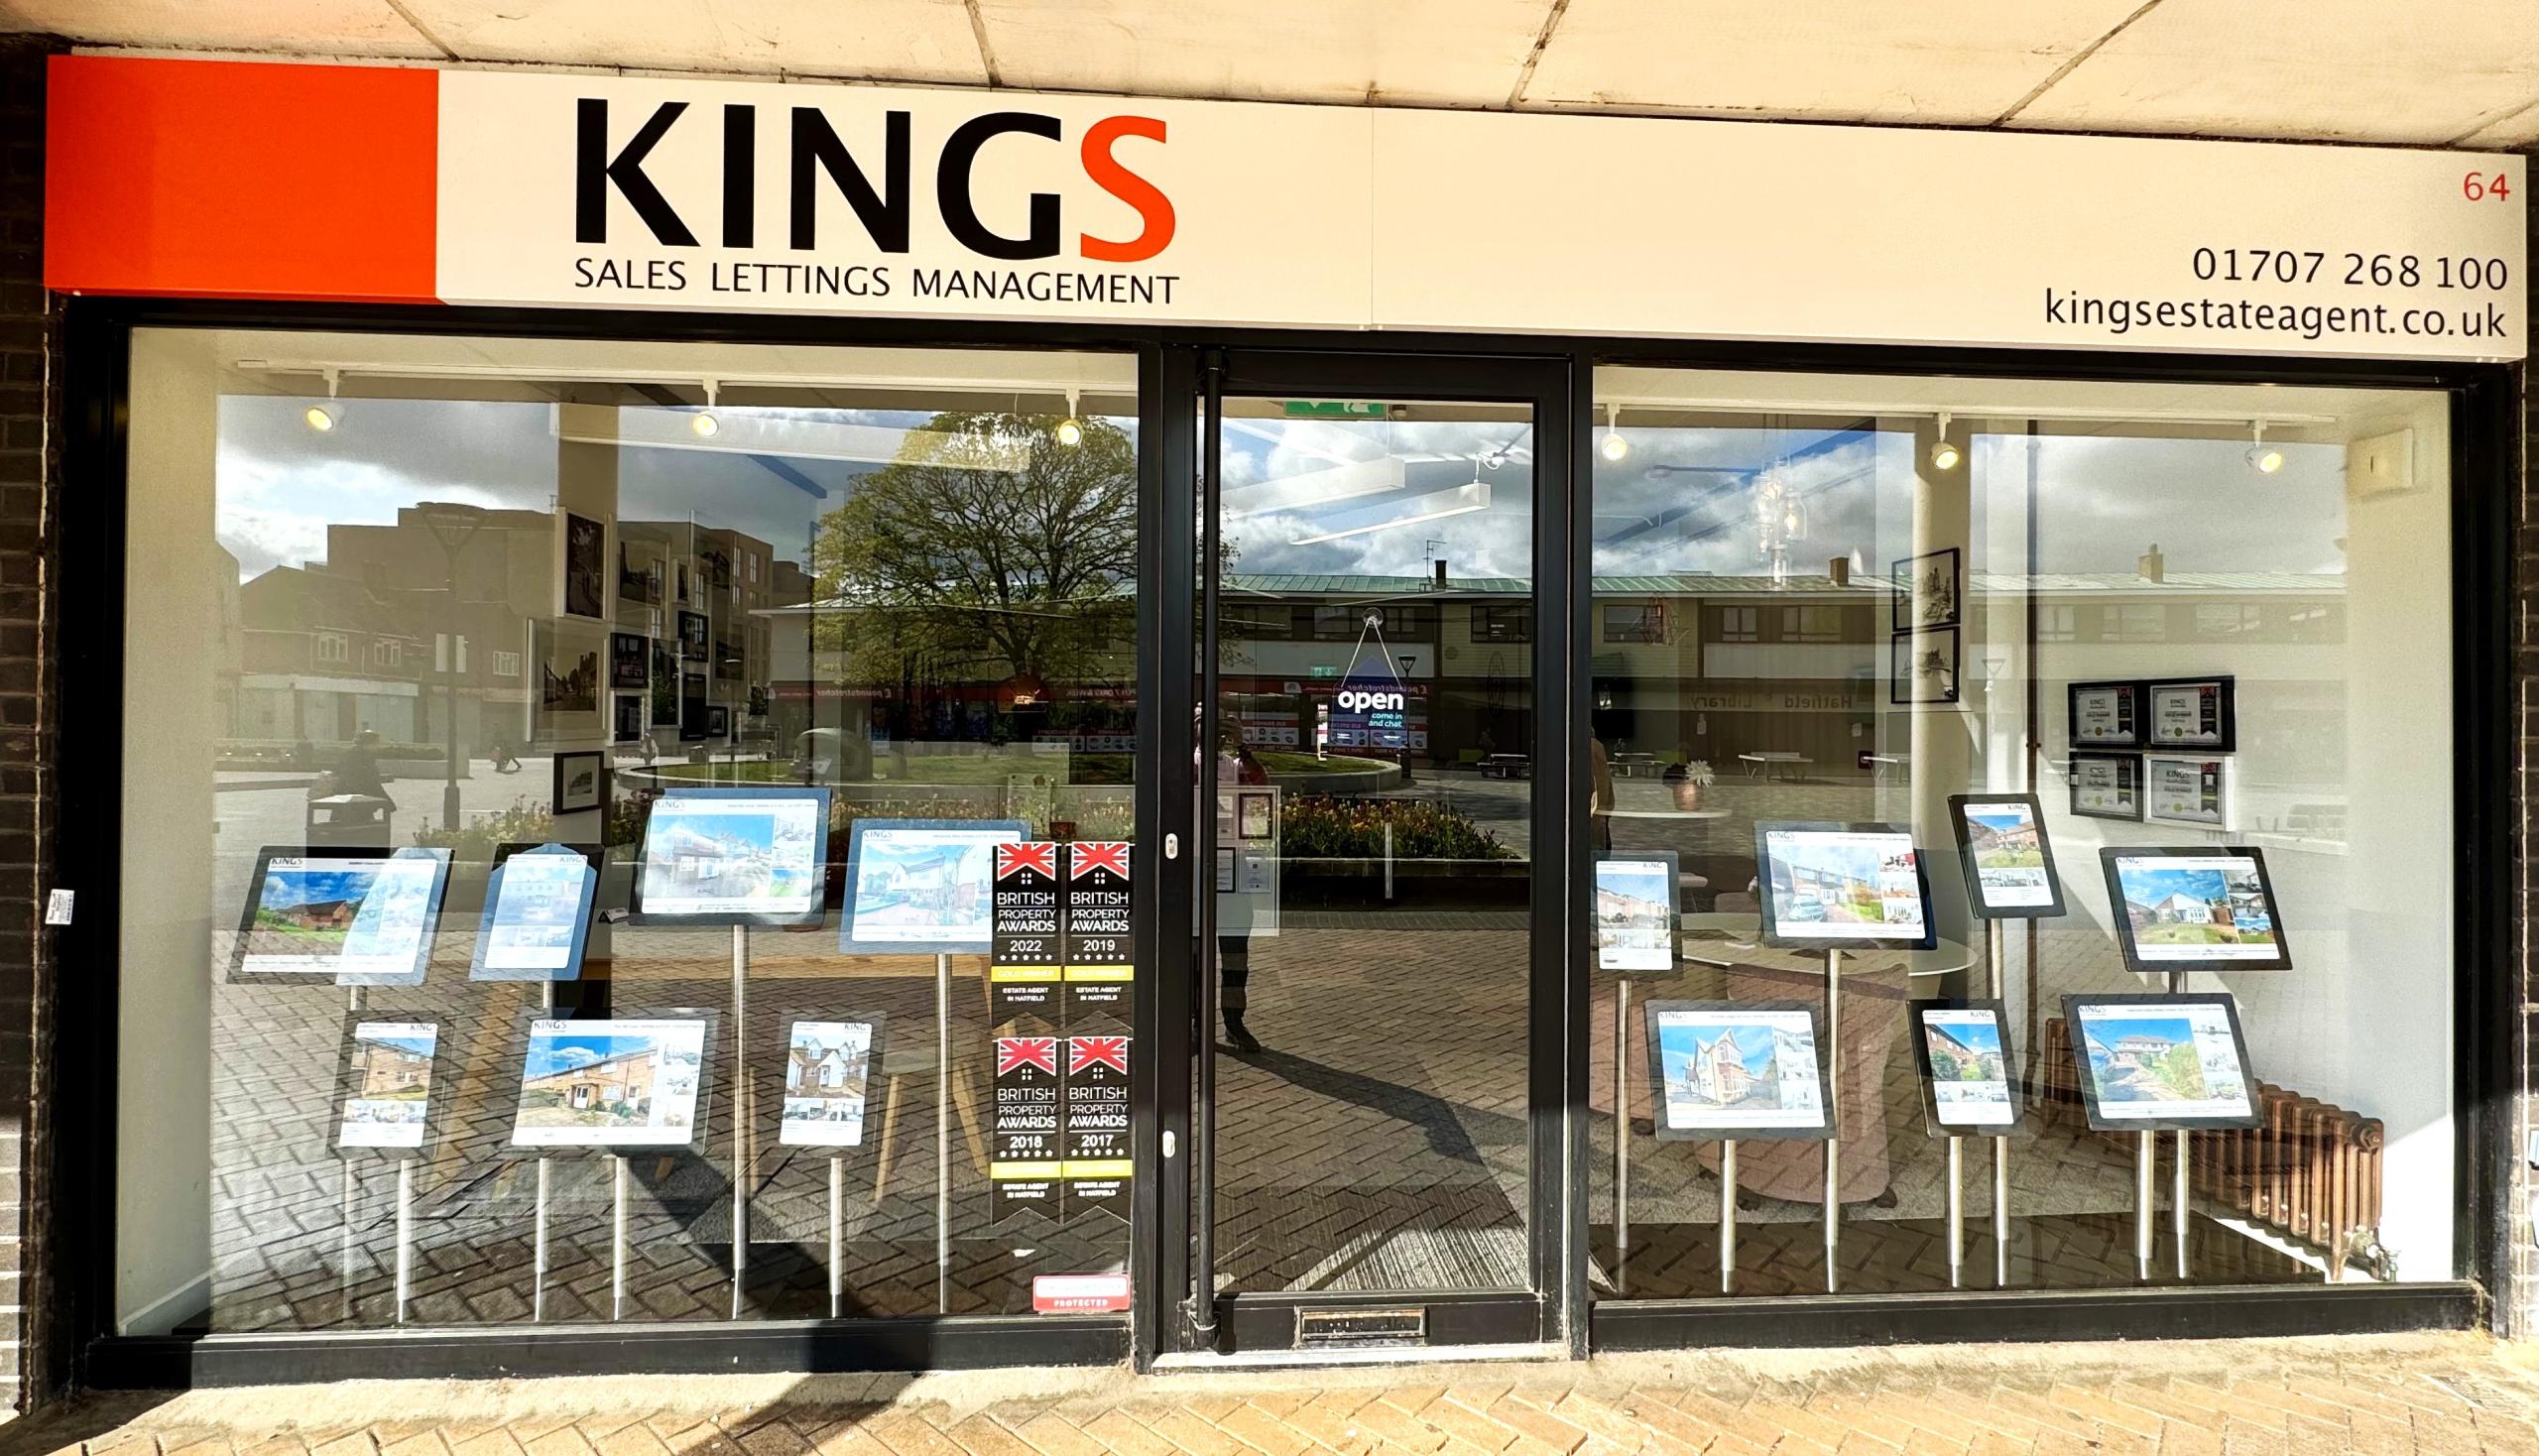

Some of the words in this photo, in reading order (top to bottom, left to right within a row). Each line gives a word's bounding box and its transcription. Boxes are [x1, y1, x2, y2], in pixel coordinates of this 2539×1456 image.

[575, 97, 1176, 262] KINGS
[2463, 172, 2510, 201] 64
[2193, 247, 2325, 283] 01707
[2345, 253, 2420, 287] 268
[2436, 257, 2508, 290] 100
[575, 257, 686, 291] SALES
[711, 262, 891, 297] LETTINGS
[912, 268, 1179, 304] MANAGEMENT
[2046, 288, 2507, 339] kingsestateagent.co.uk
[1338, 691, 1403, 713] open
[997, 892, 1055, 905] BRITISH
[1070, 892, 1129, 905] BRITISH
[998, 909, 1056, 919] PROPERTY
[1071, 909, 1130, 919] PROPERTY
[997, 919, 1056, 932] AWARDS
[1070, 919, 1129, 932] AWARDS
[1010, 939, 1042, 952] 2022
[1083, 939, 1115, 952] 2019
[998, 1087, 1056, 1102] BRITISH
[1069, 1086, 1127, 1101] BRITISH
[998, 1104, 1057, 1116] PROPERTY
[1069, 1103, 1129, 1116] PROPERTY
[997, 1116, 1056, 1129] AWARDS
[1068, 1115, 1128, 1128] AWARDS
[1010, 1135, 1043, 1150] 2018
[1081, 1134, 1114, 1148] 2017
[1054, 1298, 1109, 1307] PROTECTED
